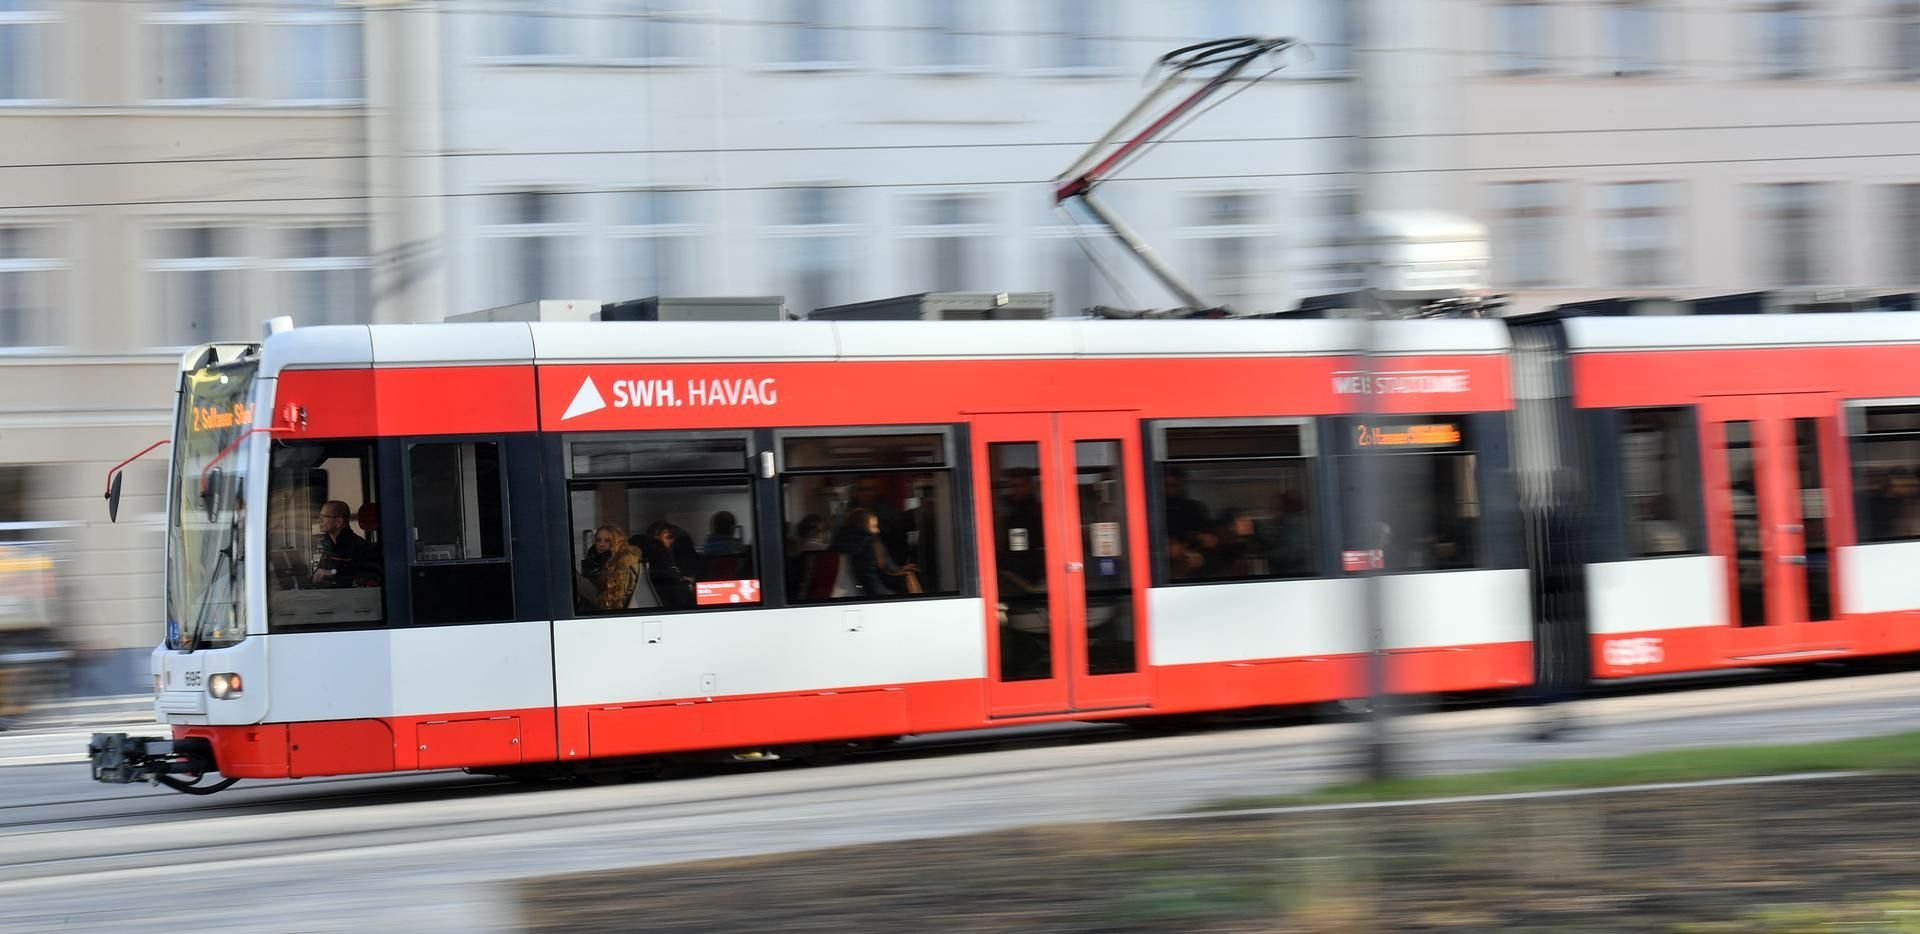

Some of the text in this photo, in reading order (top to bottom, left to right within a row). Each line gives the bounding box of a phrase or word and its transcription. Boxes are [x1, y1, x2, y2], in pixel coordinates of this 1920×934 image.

[613, 377, 778, 408] SWH. HAVAG
[193, 407, 201, 431] 2
